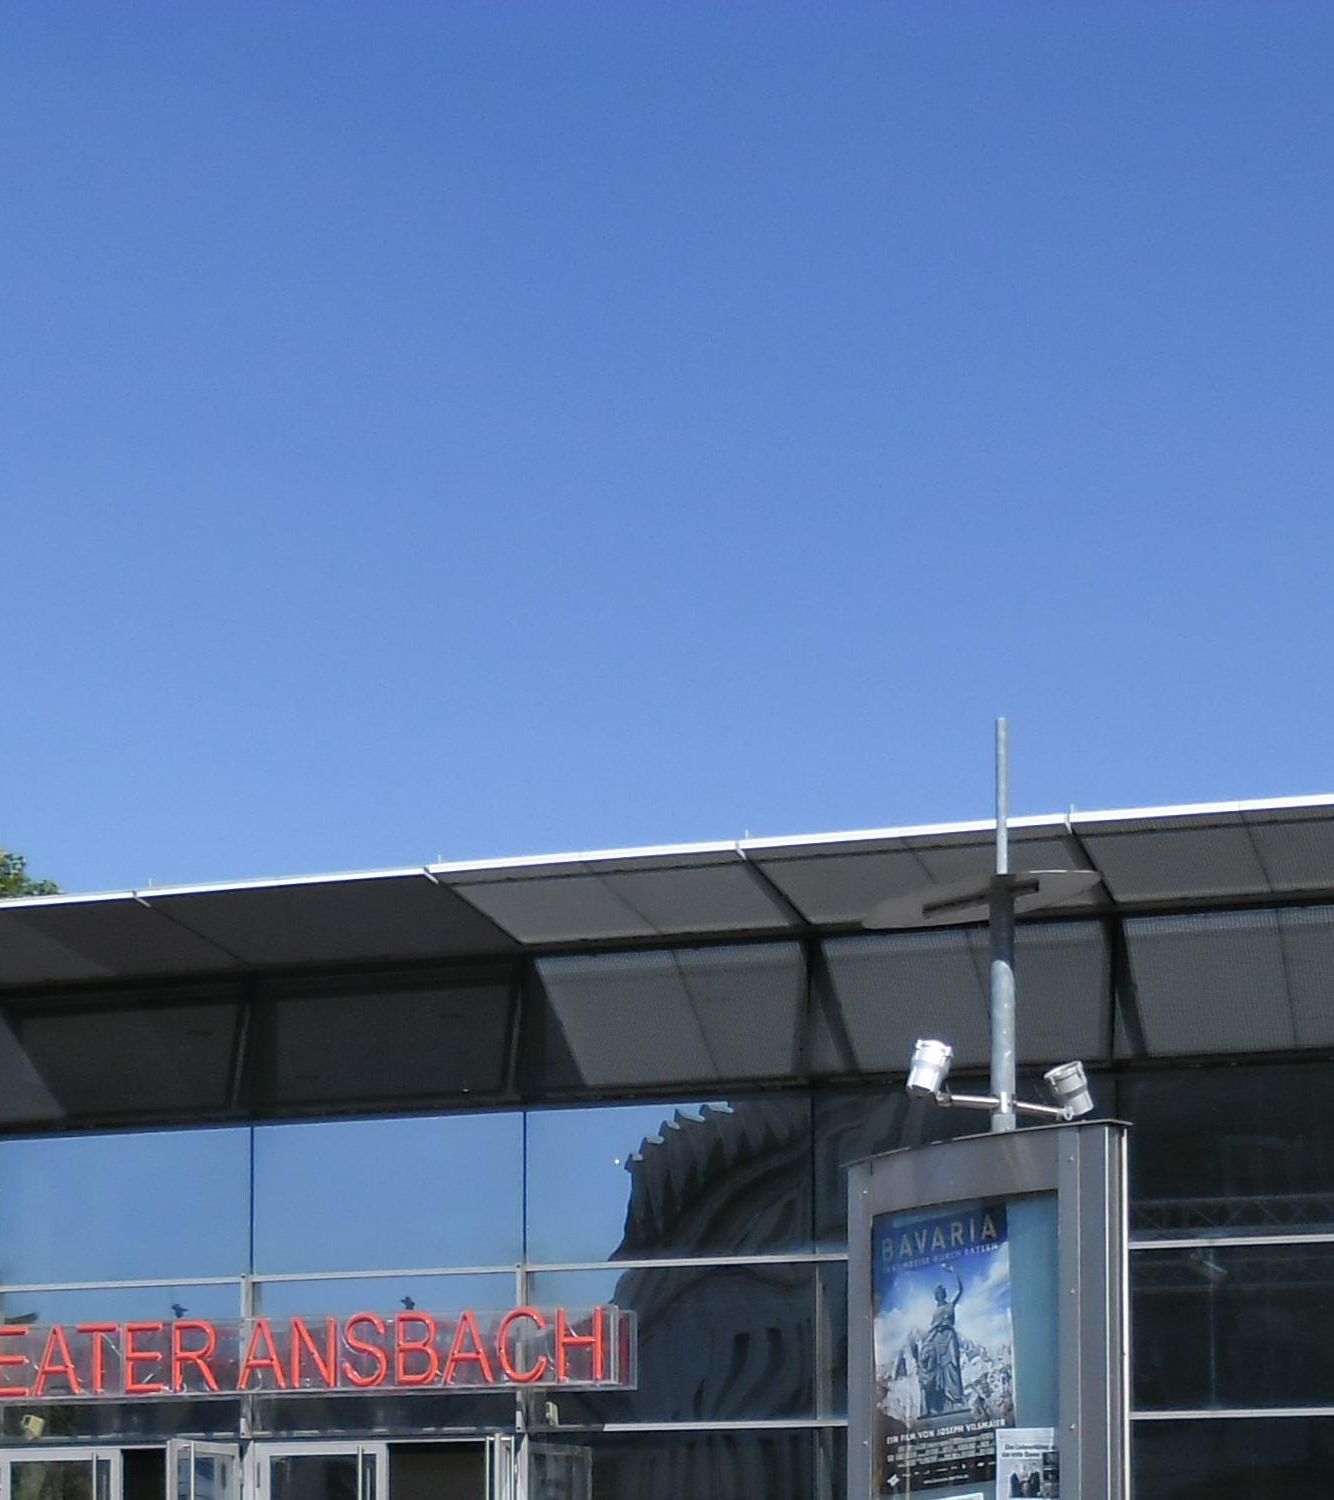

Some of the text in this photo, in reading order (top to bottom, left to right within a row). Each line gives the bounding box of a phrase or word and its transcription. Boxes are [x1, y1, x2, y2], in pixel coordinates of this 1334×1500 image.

[882, 1214, 998, 1263] BAVARIA
[238, 1306, 605, 1389] ANSBACH
[886, 1433, 899, 1445] EIN
[917, 1429, 935, 1439] VON
[936, 1424, 965, 1437] JOSEPH
[965, 1418, 1006, 1432] VILSMAIER
